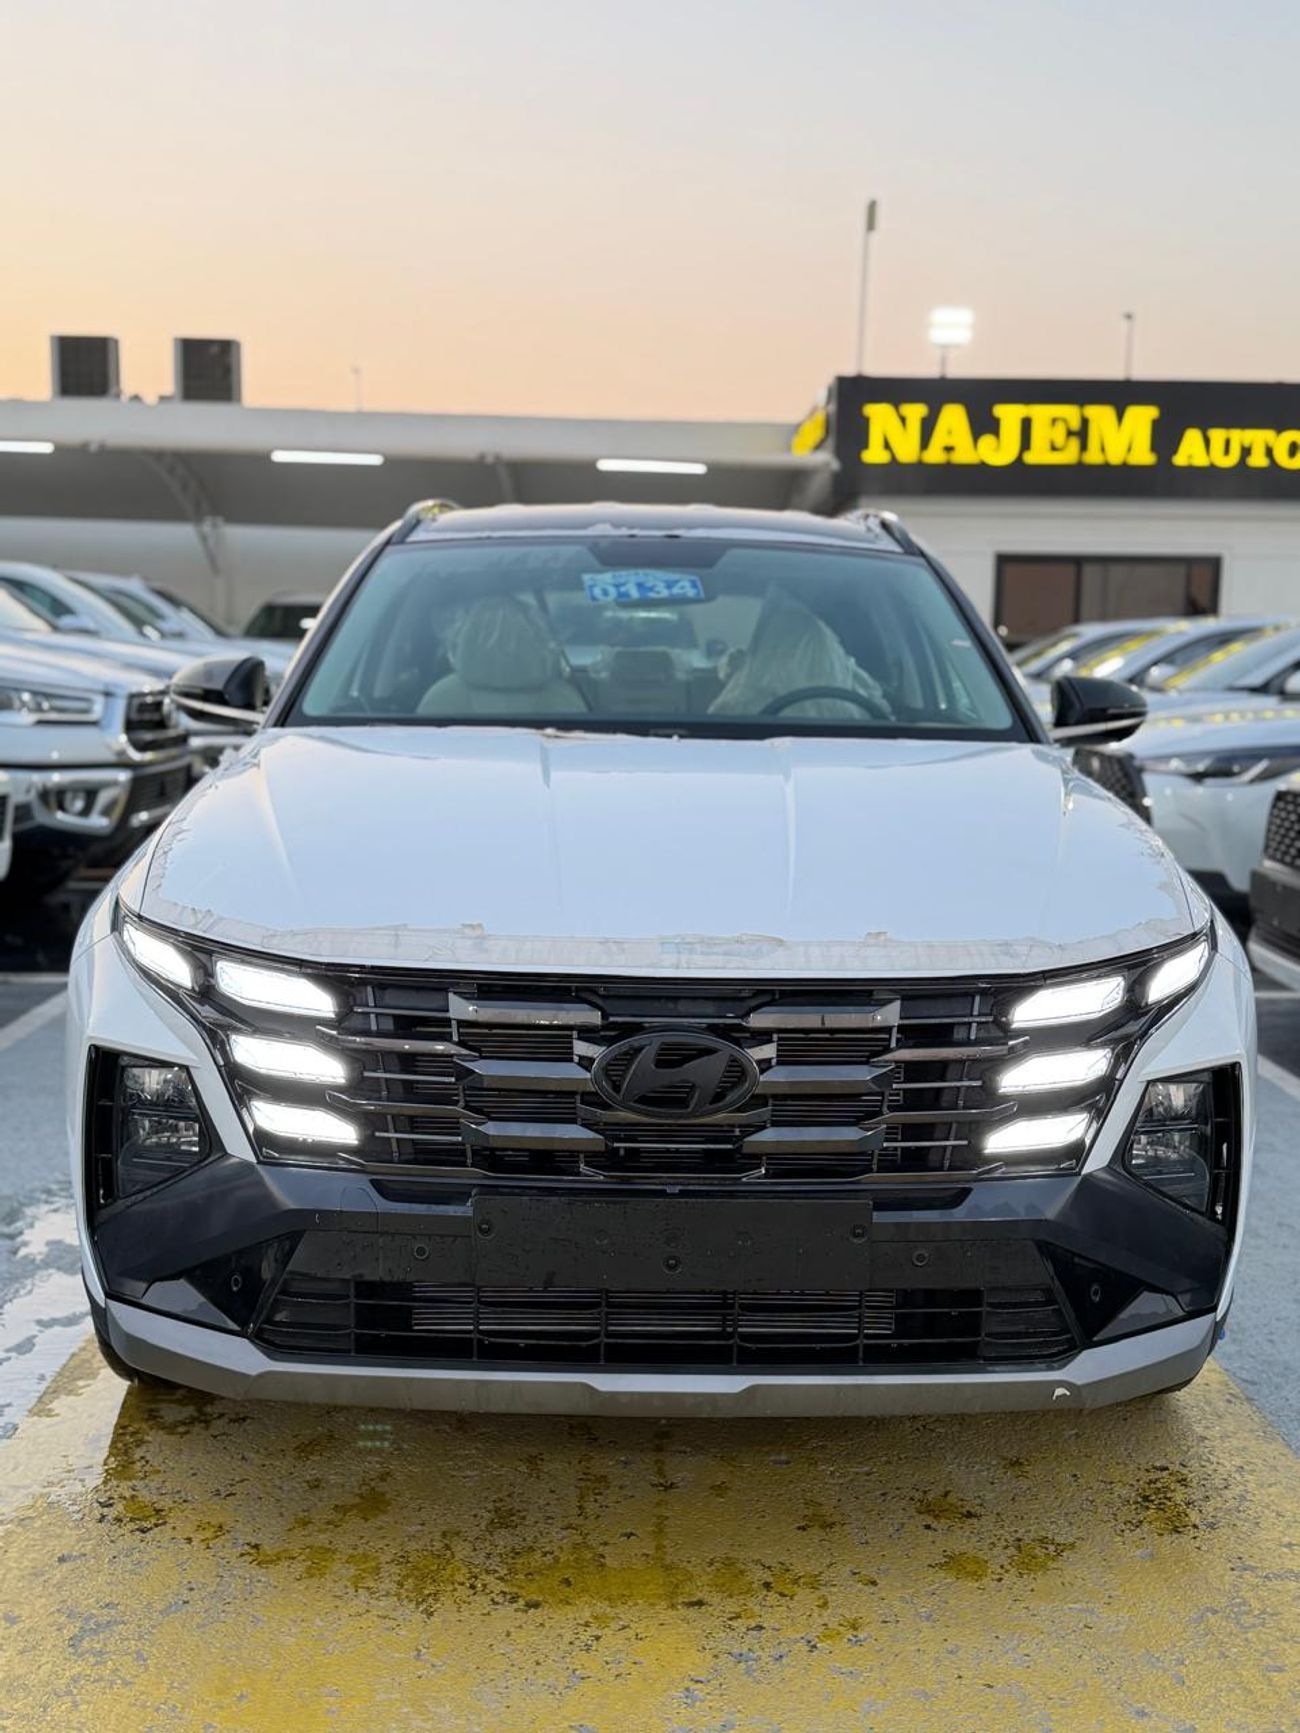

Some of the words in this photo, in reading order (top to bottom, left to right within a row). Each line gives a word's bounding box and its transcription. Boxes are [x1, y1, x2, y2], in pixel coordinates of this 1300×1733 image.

[860, 402, 1161, 467] NAJEM
[1171, 427, 1300, 470] AUTO
[592, 579, 698, 600] 0134
